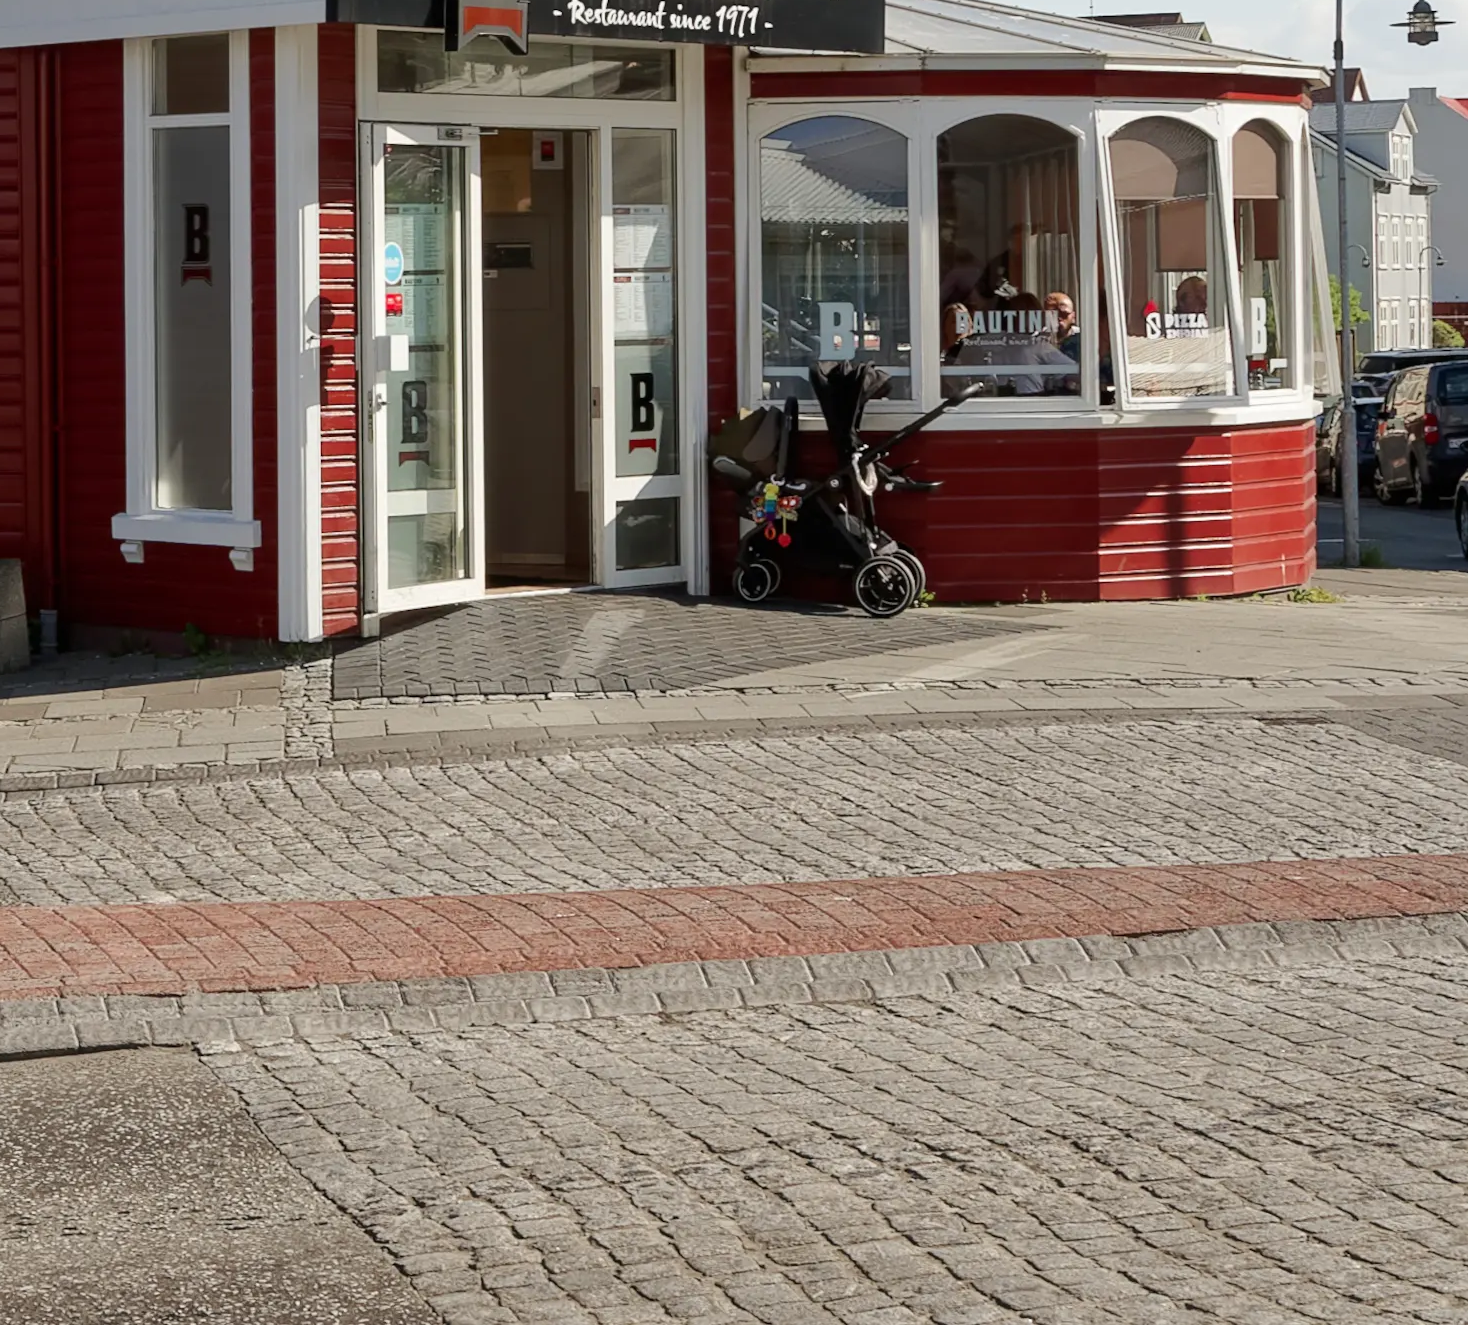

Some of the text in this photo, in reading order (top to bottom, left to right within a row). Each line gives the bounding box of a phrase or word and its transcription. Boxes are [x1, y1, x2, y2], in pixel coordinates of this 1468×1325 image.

[670, 3, 712, 31] since
[715, 4, 760, 38] 1971
[181, 203, 210, 266] B
[816, 301, 857, 361] B
[955, 310, 1059, 334] BAUTINN
[1164, 312, 1209, 328] PIZZA
[1250, 297, 1267, 354] B
[400, 380, 429, 444] B
[629, 372, 655, 433] B
